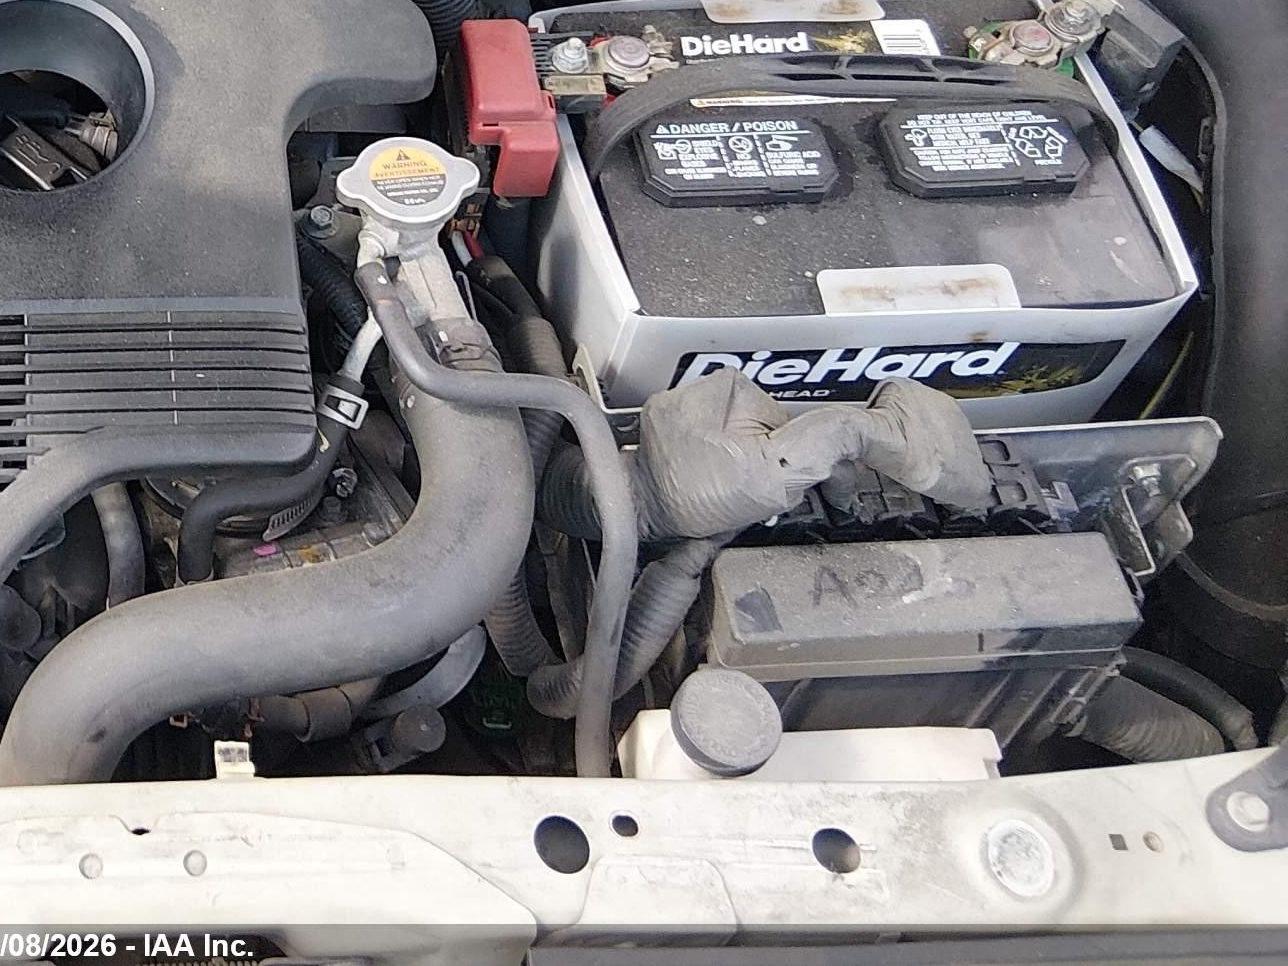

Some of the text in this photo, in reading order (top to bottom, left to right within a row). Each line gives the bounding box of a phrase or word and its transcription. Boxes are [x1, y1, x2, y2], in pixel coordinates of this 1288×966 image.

[680, 32, 810, 57] DieHard
[670, 120, 799, 134] DANGER / POISON
[383, 161, 428, 170] WARNING
